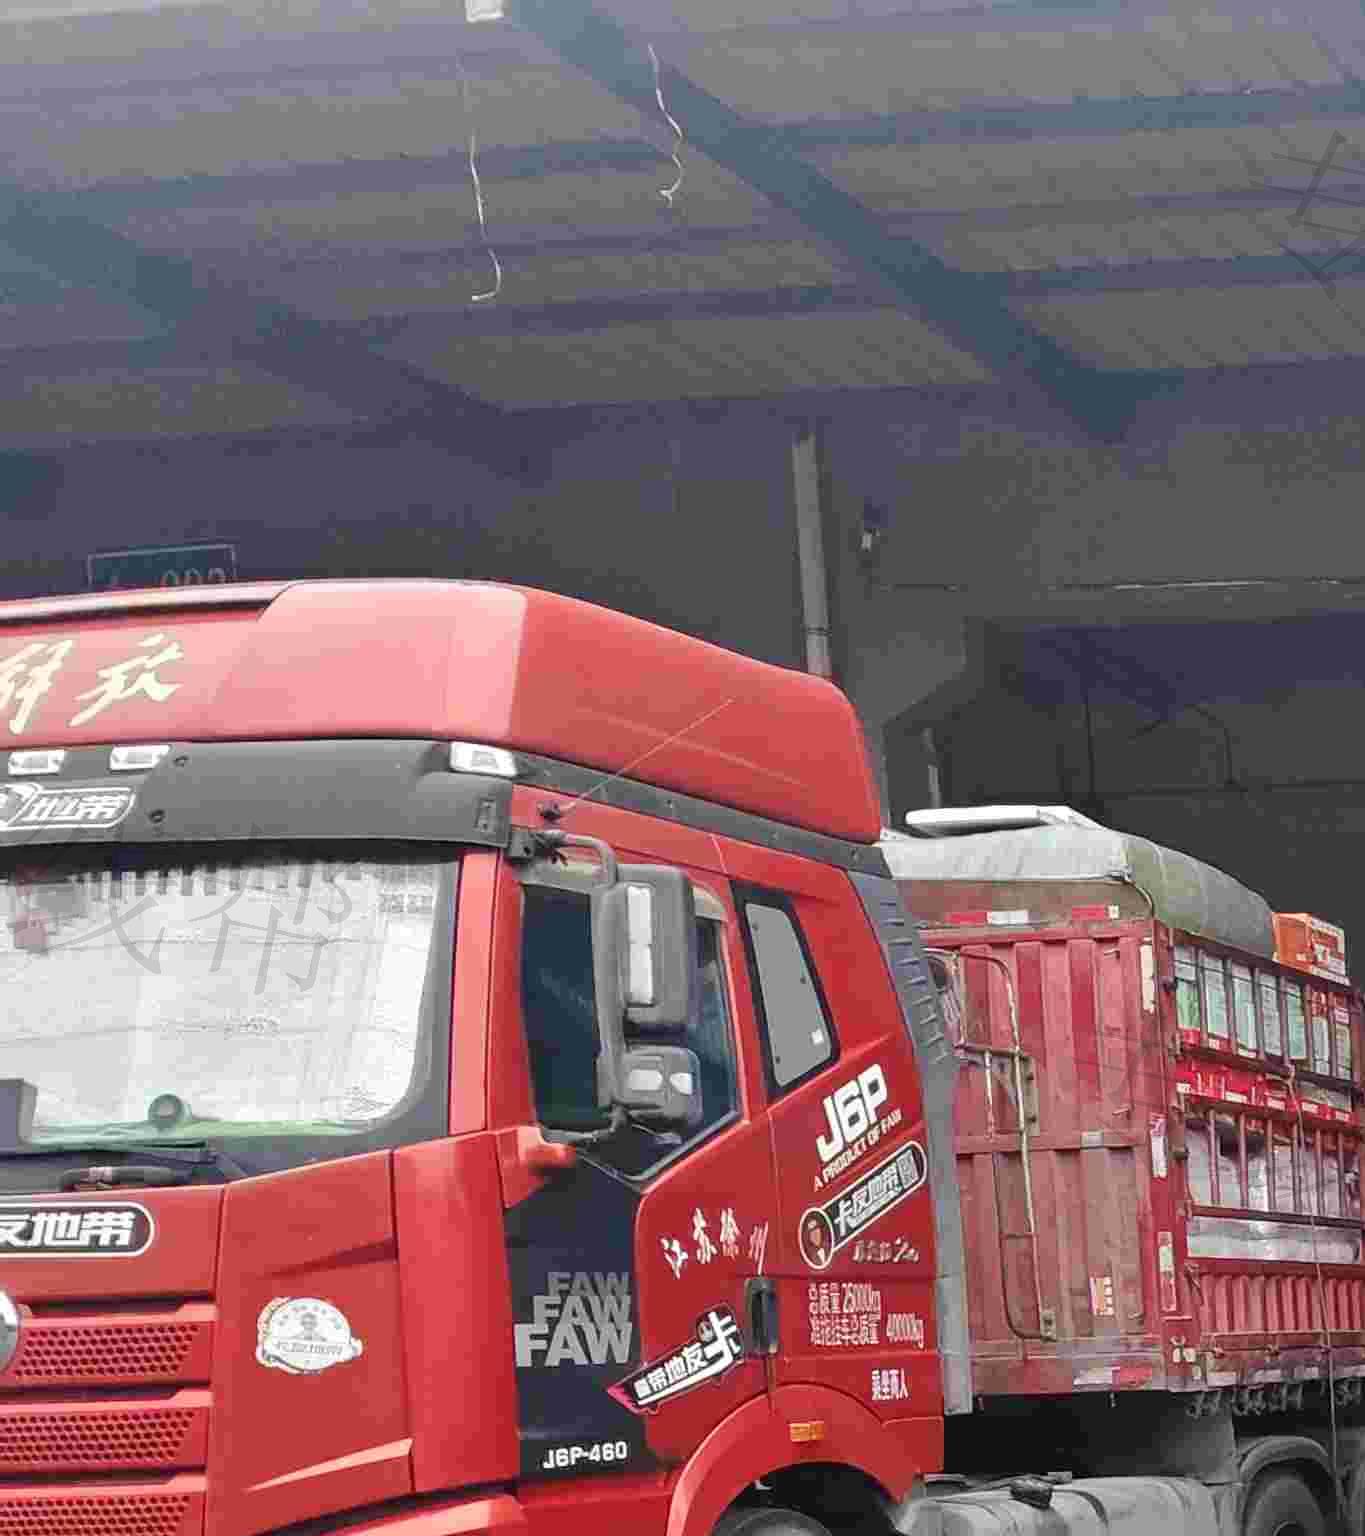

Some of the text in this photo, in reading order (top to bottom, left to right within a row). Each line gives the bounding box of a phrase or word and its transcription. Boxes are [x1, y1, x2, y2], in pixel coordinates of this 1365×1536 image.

[816, 1063, 888, 1163] J6P
[547, 1271, 630, 1297] FAW
[533, 1295, 632, 1327] FAW
[514, 1322, 633, 1368] FAW
[543, 1441, 628, 1470] J6P-460
